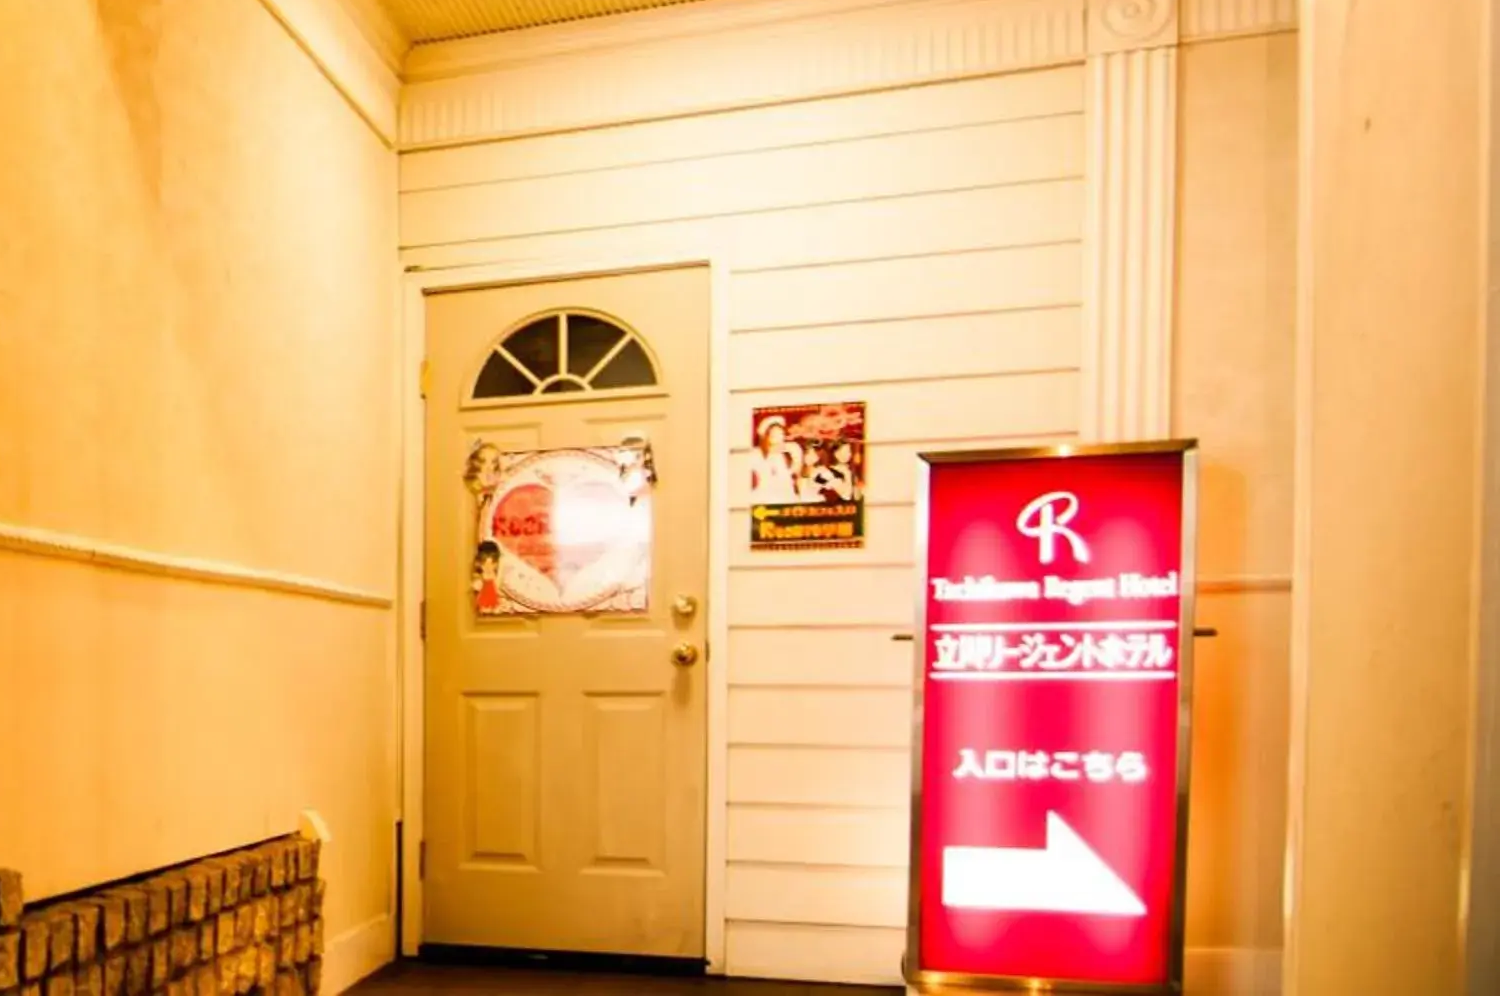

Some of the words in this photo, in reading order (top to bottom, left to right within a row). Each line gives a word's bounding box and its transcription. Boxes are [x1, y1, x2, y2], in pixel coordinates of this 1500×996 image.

[1119, 571, 1178, 598] Hotel
[952, 747, 1148, 783] 入口はこちら
